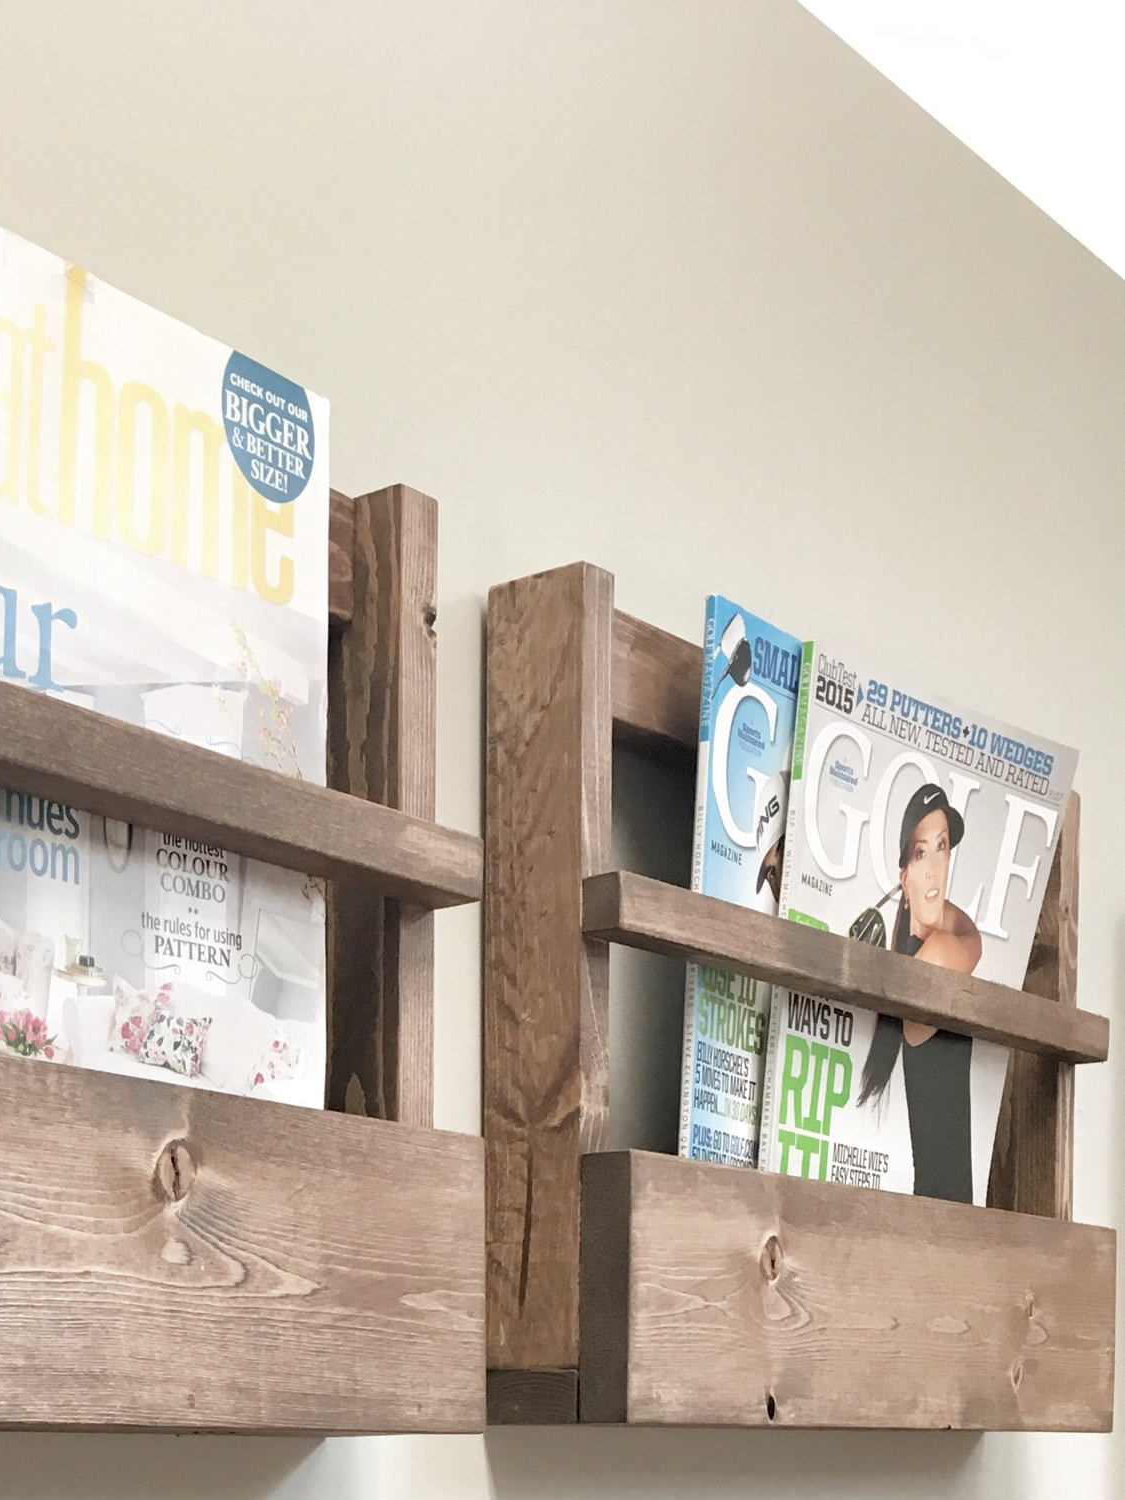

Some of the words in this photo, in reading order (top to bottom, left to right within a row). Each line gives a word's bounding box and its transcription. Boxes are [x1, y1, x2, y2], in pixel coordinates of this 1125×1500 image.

[230, 373, 264, 400] CHECK
[266, 391, 286, 411] OUT
[288, 403, 309, 423] OUR
[225, 389, 313, 461] BIGGER
[232, 426, 246, 450] &
[246, 432, 306, 480] BETTER
[250, 458, 288, 494] SIZE!
[816, 675, 854, 715] 2015
[867, 679, 888, 707] 29
[890, 689, 963, 740] PUTTERS
[969, 724, 988, 750] 10
[990, 732, 1054, 776] WEDGES
[861, 703, 887, 731] ALL
[888, 714, 923, 748] NEW,
[925, 728, 974, 767] TESTED
[975, 752, 1005, 779] AND
[1005, 763, 1051, 797] RATED
[805, 721, 1059, 940] GOLF
[156, 848, 230, 882] COLOUR
[711, 840, 742, 865] MAGAZINE
[160, 873, 226, 903] COMBO
[801, 873, 833, 897] MAGAZINE
[141, 911, 161, 931] the
[164, 917, 192, 937] rules
[195, 921, 210, 940] for
[213, 928, 243, 951] using
[154, 935, 231, 967] PATTERN
[699, 991, 765, 1056] STROKES
[788, 992, 831, 1041] WAYS
[834, 1008, 854, 1047] TO
[695, 1063, 701, 1084] 5
[722, 1072, 730, 1093] TO
[730, 1075, 748, 1099] MAKE
[748, 1081, 756, 1101] IT
[779, 1033, 853, 1136] RIP
[713, 1129, 722, 1151] GO
[722, 1132, 730, 1154] TO
[832, 1142, 868, 1169] MICHELLE
[868, 1151, 889, 1174] WIE'S
[831, 1164, 849, 1186] EASY
